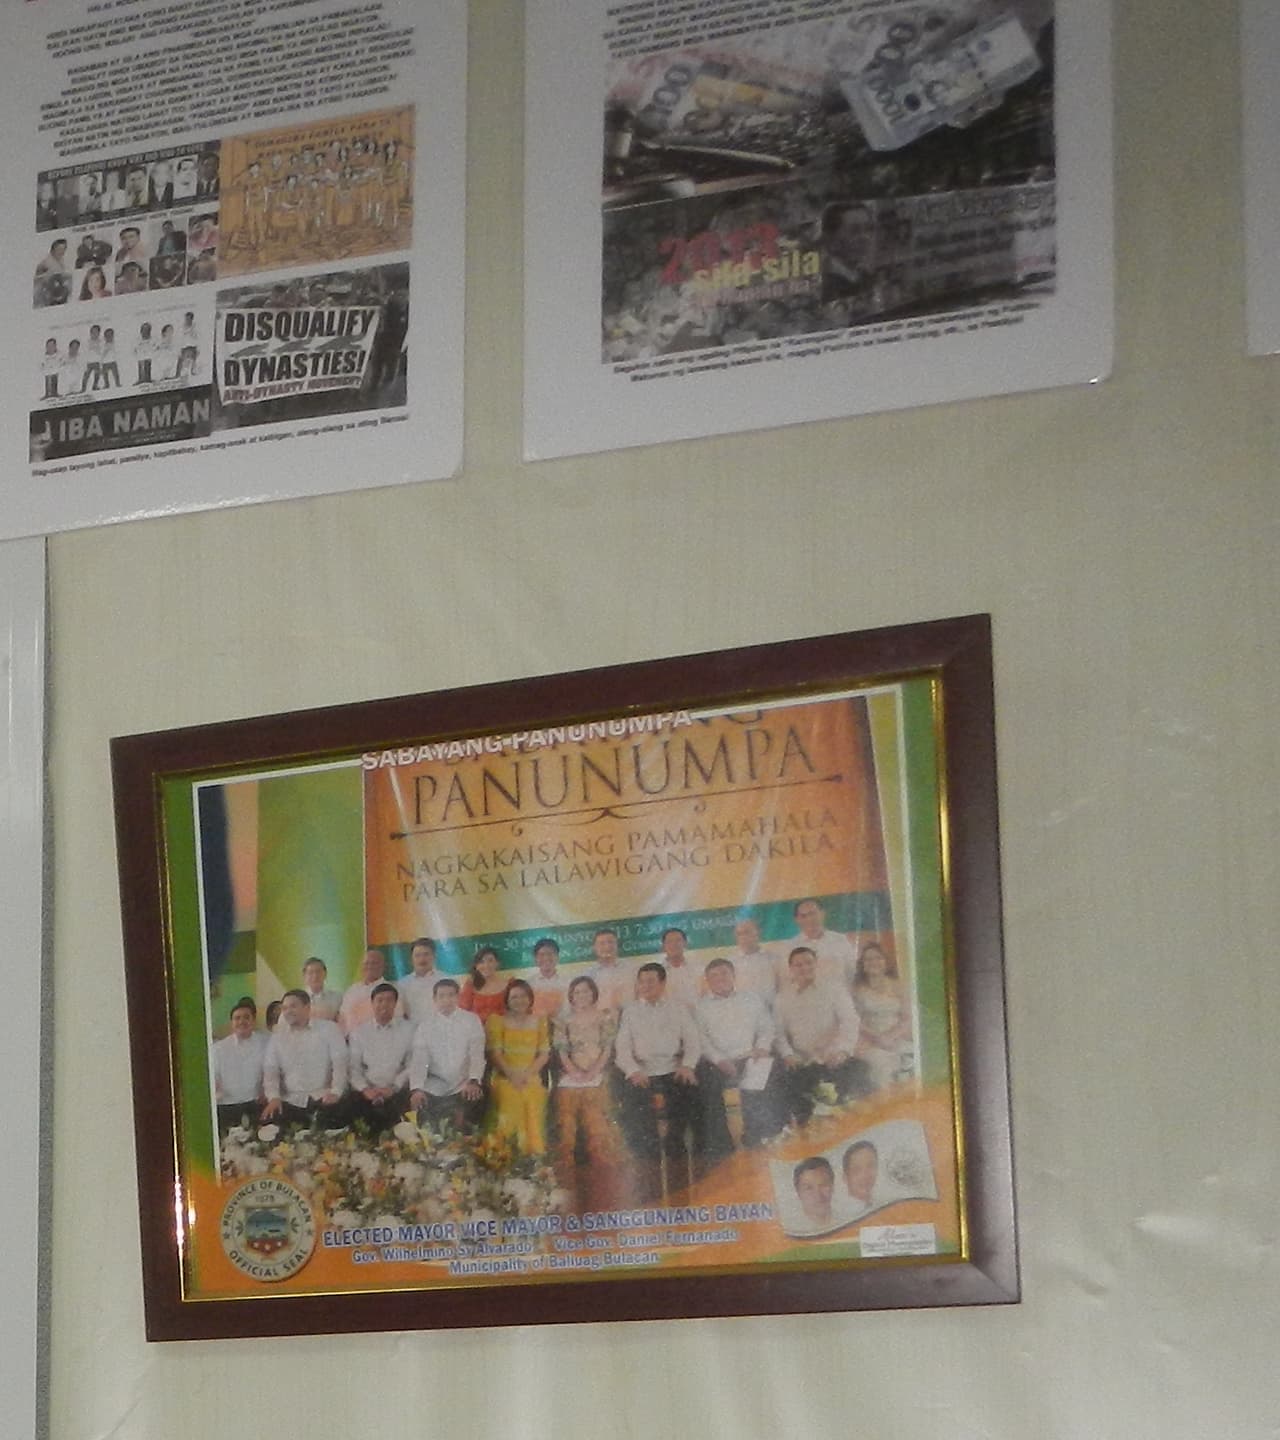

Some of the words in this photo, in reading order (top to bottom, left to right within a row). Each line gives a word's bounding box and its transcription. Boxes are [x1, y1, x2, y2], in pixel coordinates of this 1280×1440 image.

[224, 310, 375, 344] DISQUALIFY
[223, 351, 366, 388] DYNASTIES!
[59, 414, 103, 442] IBA
[113, 399, 210, 434] NAMAN
[413, 725, 817, 826] PANUNUMPA
[396, 833, 616, 880] NAGKAKAISANG
[627, 807, 839, 851] PAMAMAHALA
[403, 876, 470, 903] PARA
[478, 872, 508, 895] SA
[520, 845, 711, 889] LALAWIGANG
[724, 831, 837, 862] DAKILA
[276, 1182, 312, 1223] BULACAN
[323, 1229, 394, 1248] ELECTED
[398, 1223, 456, 1243] MAYOR
[460, 1219, 497, 1240] VICE
[502, 1215, 562, 1236] MAYOR
[566, 1214, 580, 1231] &
[582, 1206, 711, 1231] SANGGUNIANG
[715, 1202, 774, 1222] BAYAN
[229, 1250, 279, 1277] OFFICIAL
[282, 1249, 308, 1271] SEAL
[449, 1256, 528, 1276] Municipality
